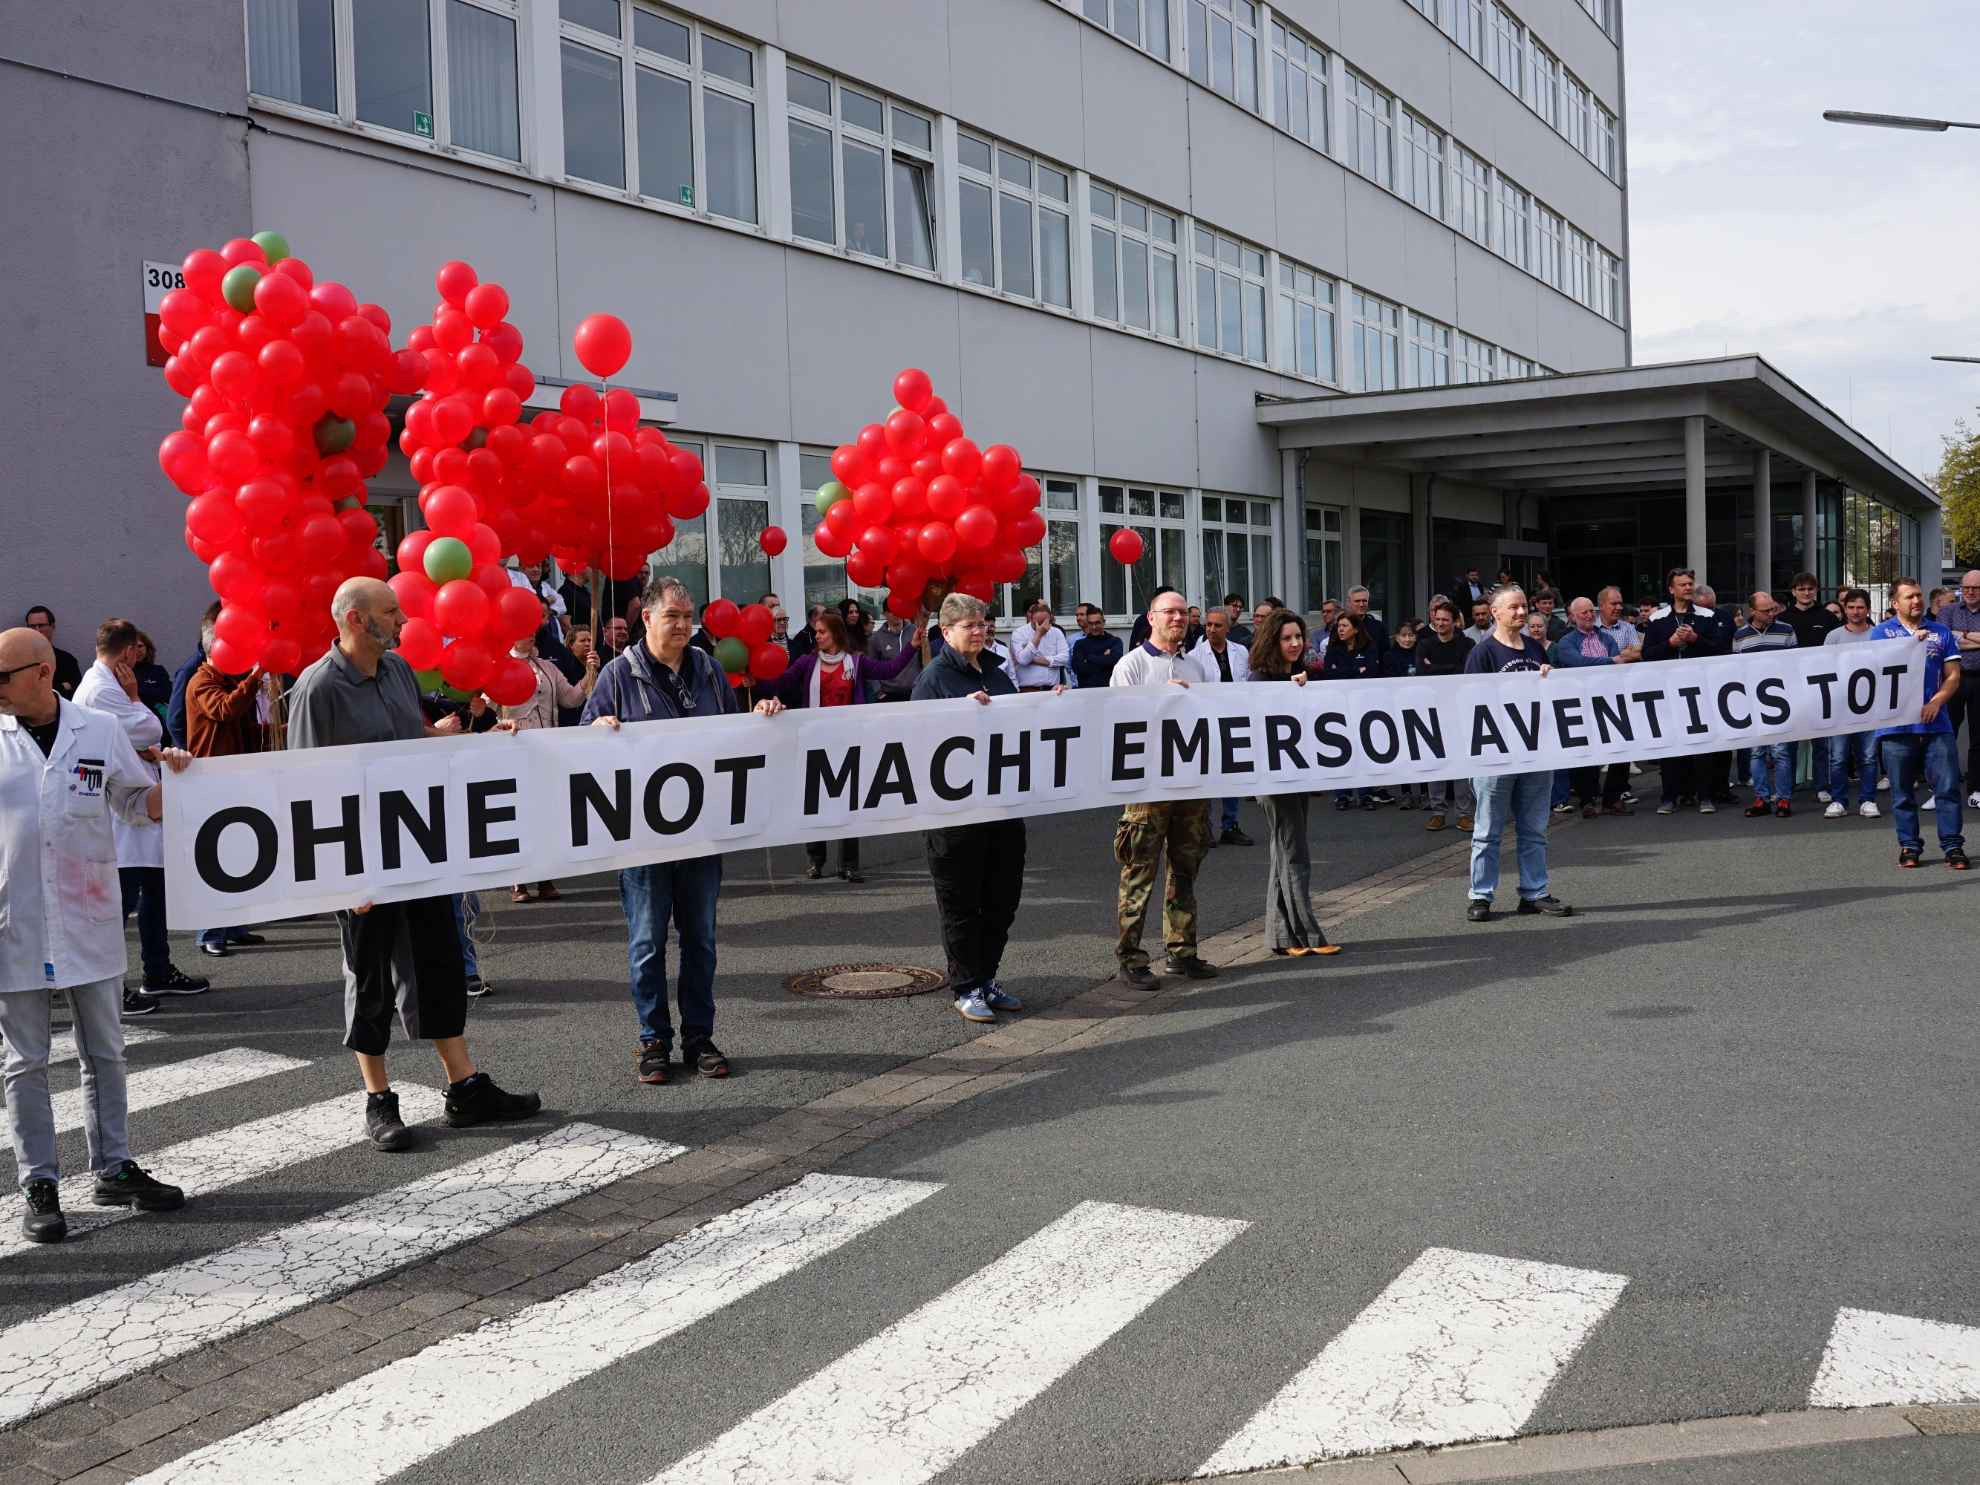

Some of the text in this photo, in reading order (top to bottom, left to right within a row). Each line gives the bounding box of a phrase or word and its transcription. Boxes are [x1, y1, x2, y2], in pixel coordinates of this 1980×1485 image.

[148, 268, 186, 289] 308
[194, 664, 1908, 894] OHNE NOT MACHT EMERSON AVENTICS TOT
